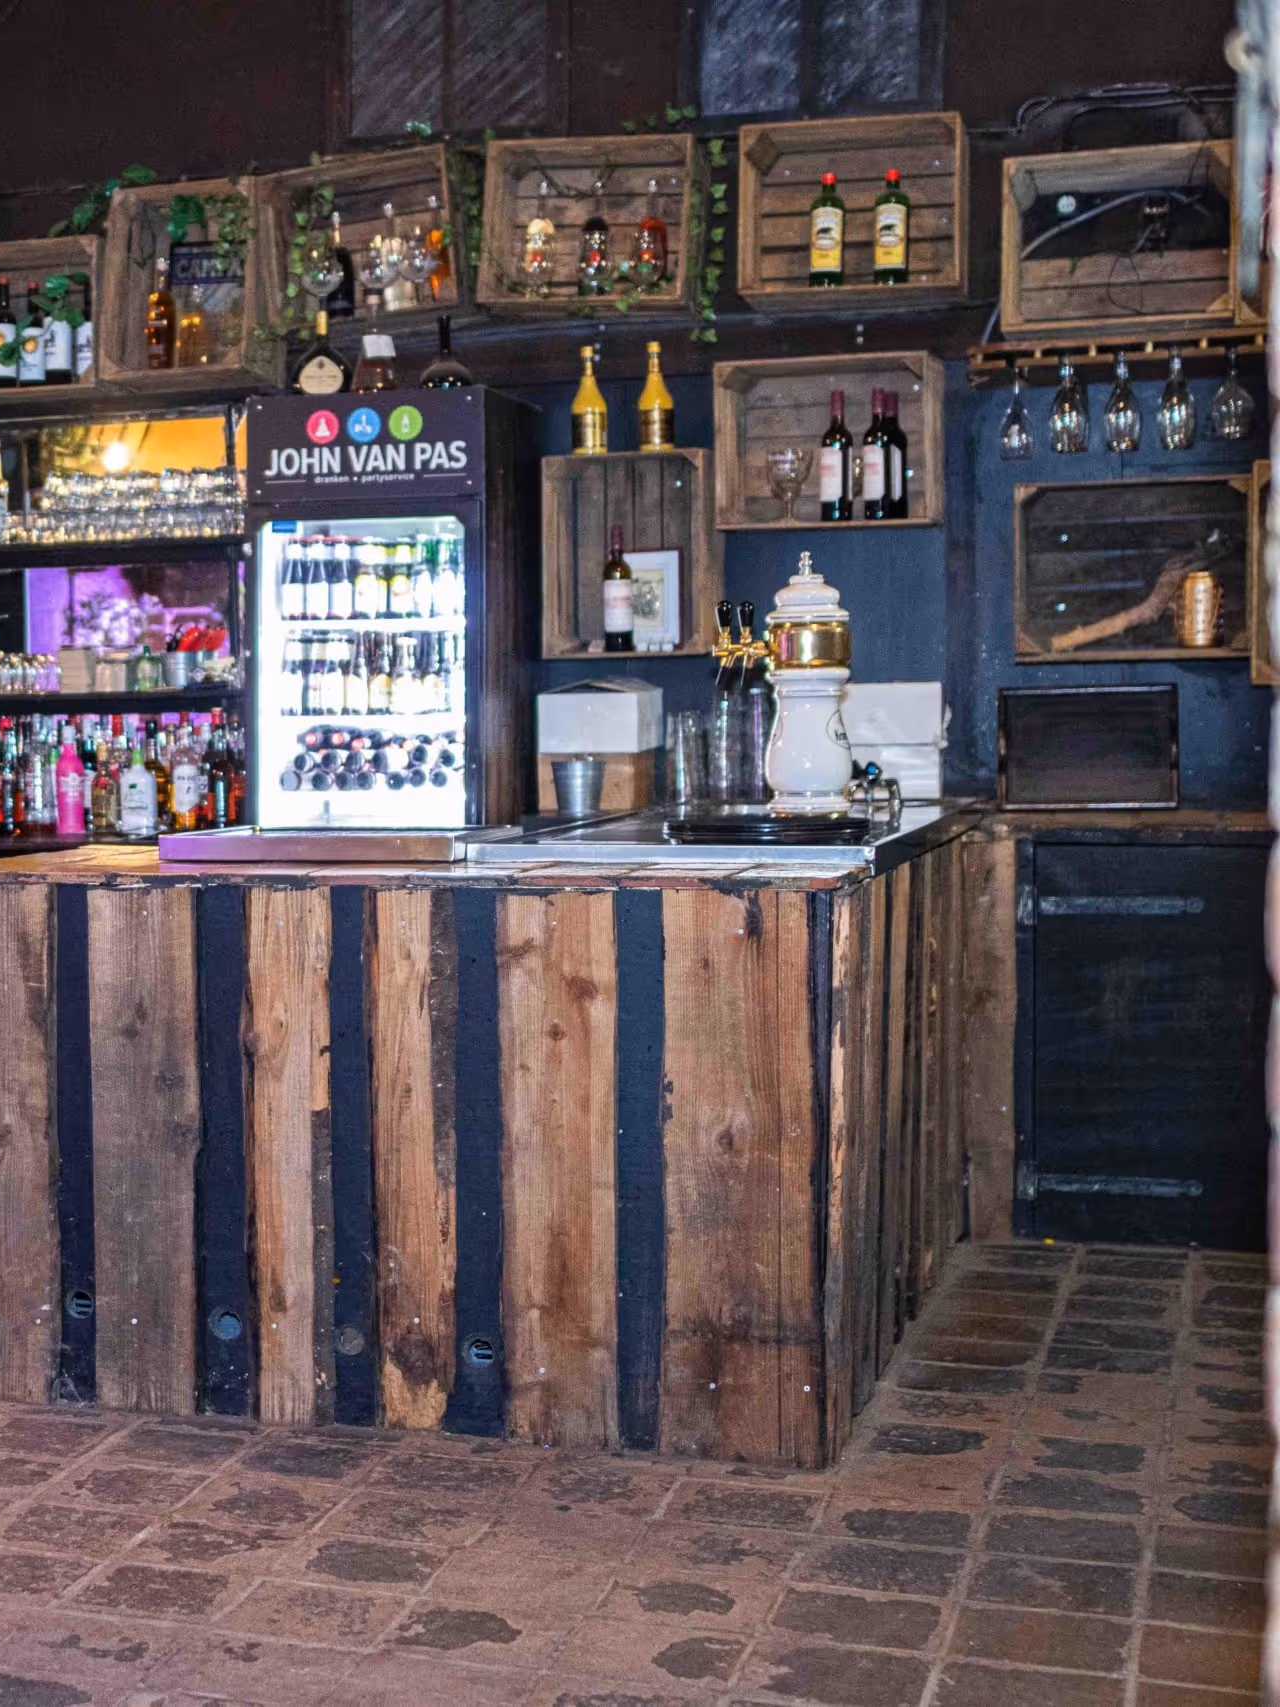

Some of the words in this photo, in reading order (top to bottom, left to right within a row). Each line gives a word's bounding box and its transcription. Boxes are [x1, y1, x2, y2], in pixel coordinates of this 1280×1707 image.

[264, 446, 341, 477] JOHN
[348, 443, 406, 473] VAN
[415, 440, 468, 469] PAS
[314, 474, 350, 484] dranken
[360, 472, 415, 484] partyservice
